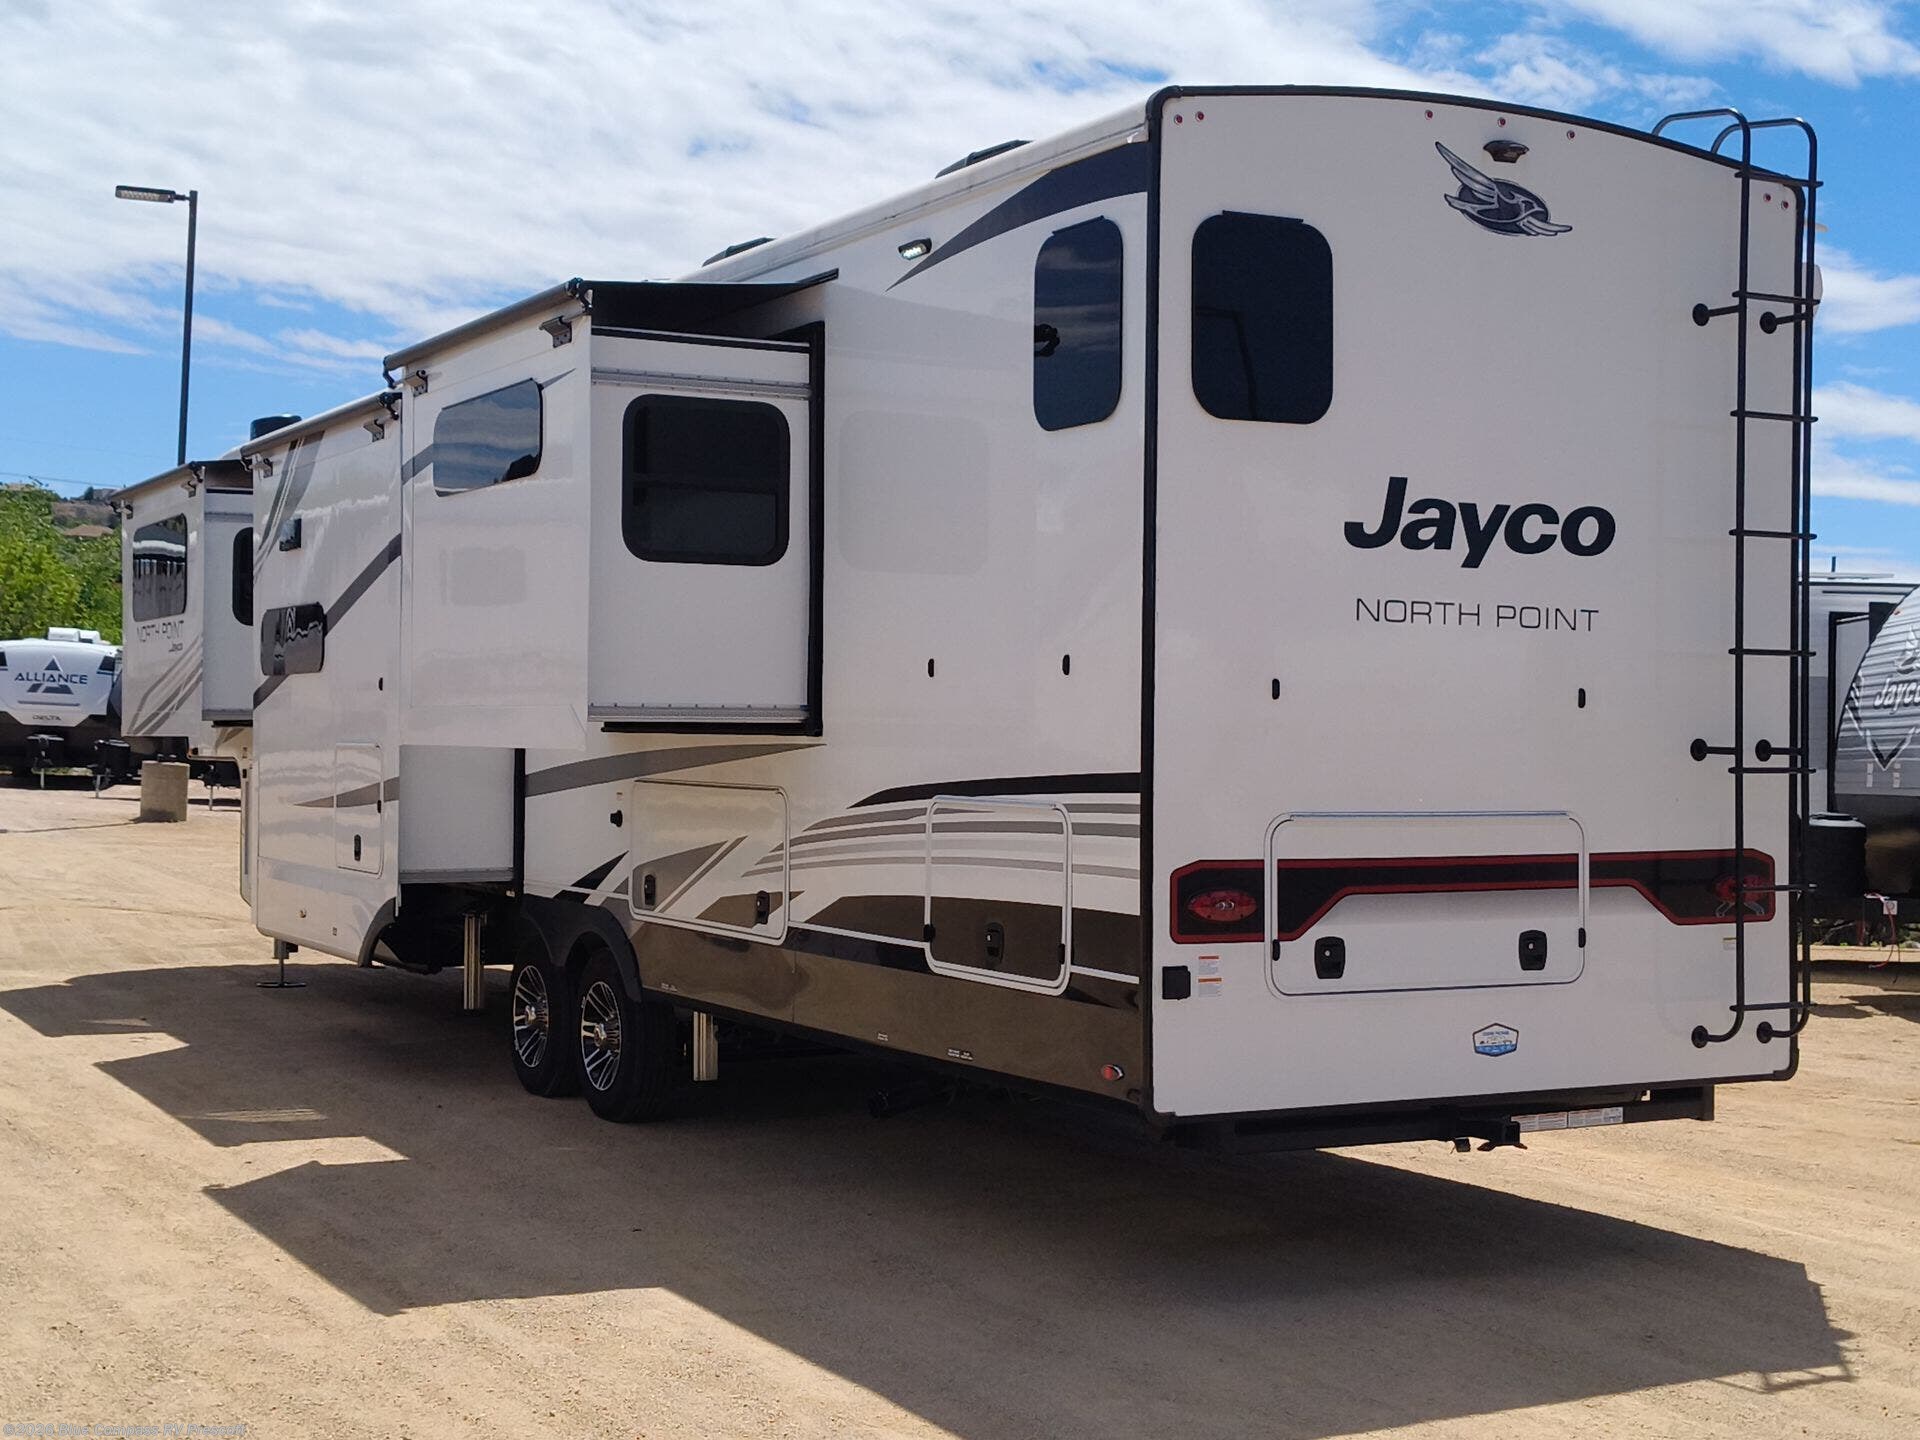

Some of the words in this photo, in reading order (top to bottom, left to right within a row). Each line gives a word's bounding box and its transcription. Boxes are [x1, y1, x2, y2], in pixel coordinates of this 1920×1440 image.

[1344, 476, 1616, 568] Jayco
[1356, 598, 1480, 627] NORTH
[1496, 604, 1599, 632] POINT
[14, 671, 88, 685] ALLIANCE
